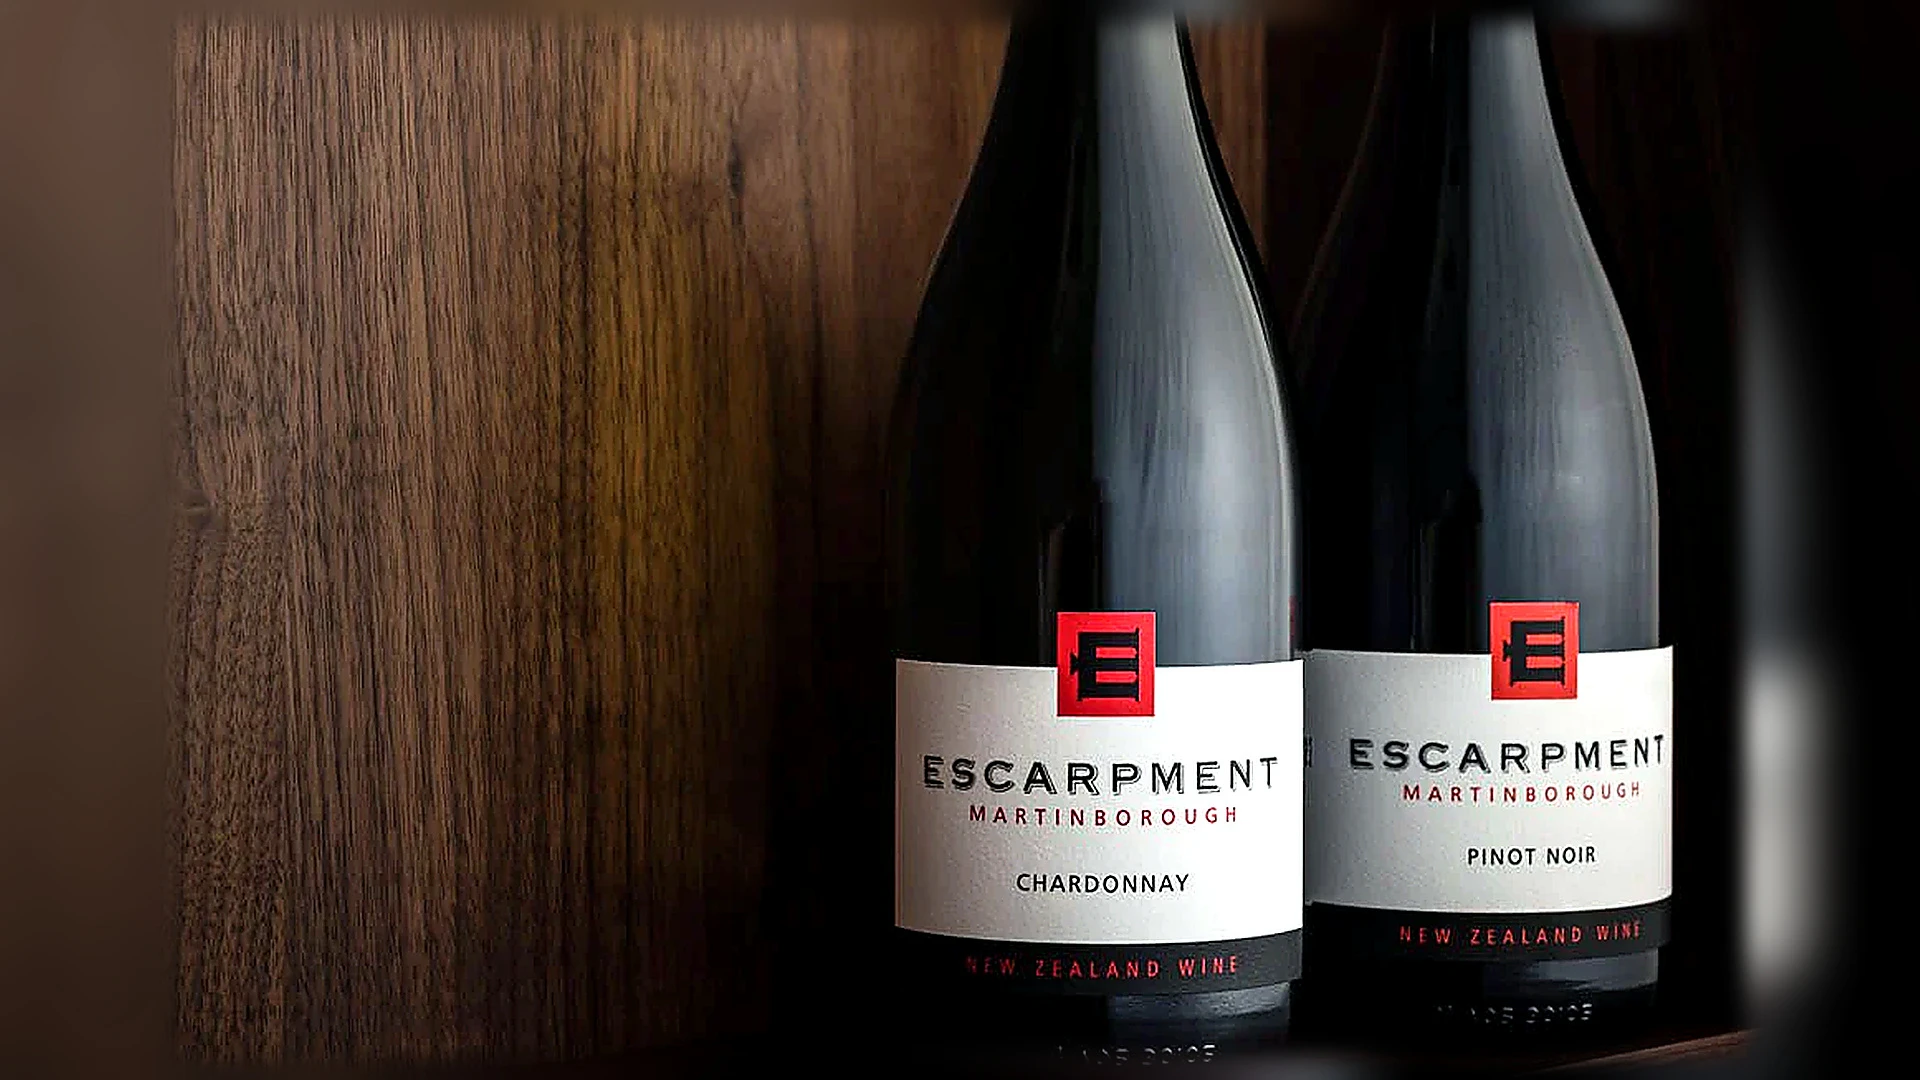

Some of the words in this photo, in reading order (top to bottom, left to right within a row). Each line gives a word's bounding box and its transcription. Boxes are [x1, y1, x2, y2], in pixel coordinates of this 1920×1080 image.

[1503, 616, 1565, 687] E
[1070, 628, 1140, 702] E
[1348, 733, 1664, 774] ESCARPMENT
[923, 754, 1279, 796] ESCARPMENT
[1403, 781, 1640, 803] MARTINBOROUGH
[969, 804, 1237, 827] MARTINBOROUGH
[1467, 848, 1536, 866] PINOT
[1546, 846, 1596, 865] NOIR
[1016, 873, 1189, 894] CHARDONNAY
[1399, 927, 1450, 944] NEW
[1470, 926, 1581, 945] ZEALAND
[1596, 922, 1640, 941] WINE
[966, 956, 1015, 976] NEW
[1035, 958, 1160, 978] ZEALAND
[1177, 954, 1237, 977] WINE
